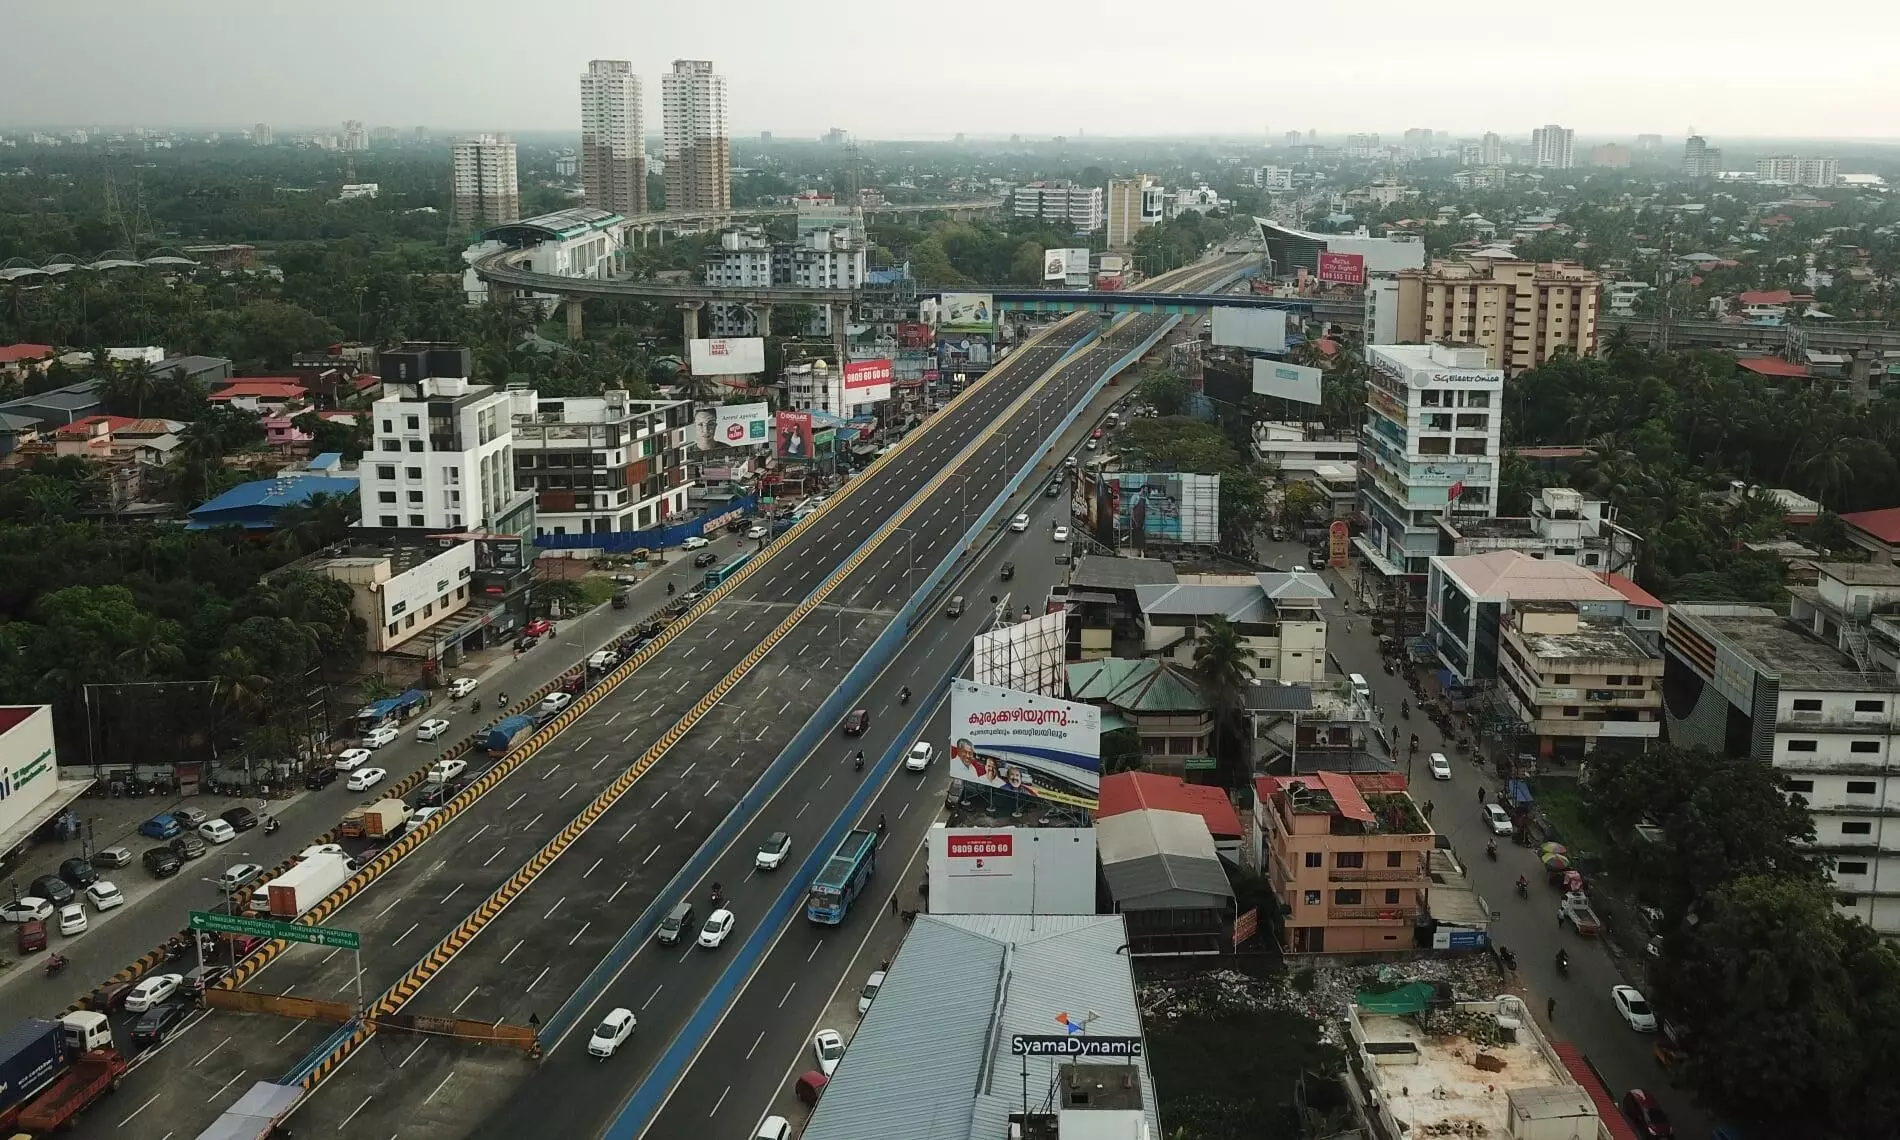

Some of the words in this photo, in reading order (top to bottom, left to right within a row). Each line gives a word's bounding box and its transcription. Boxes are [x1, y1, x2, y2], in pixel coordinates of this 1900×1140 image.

[863, 371, 872, 381] 60
[872, 370, 881, 379] 60
[881, 368, 890, 378] 60
[952, 844, 973, 853] 9809
[973, 844, 984, 853] 60
[985, 844, 996, 853] 60
[997, 844, 1008, 853] 60
[1013, 1037, 1141, 1055] SyamaDynamic
